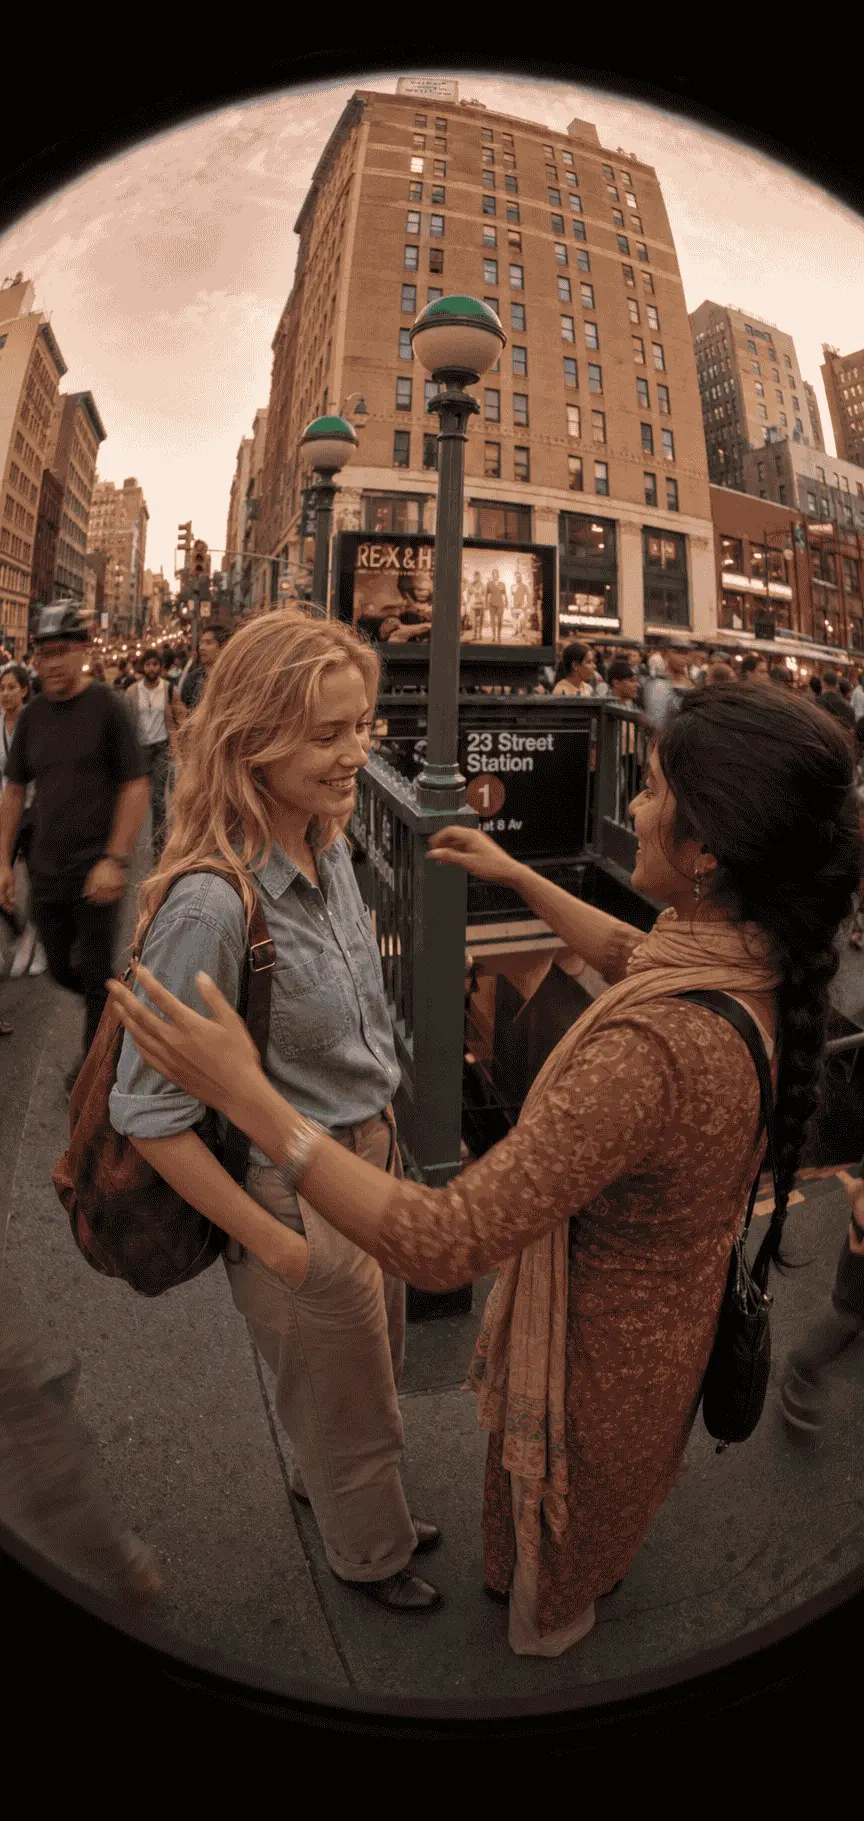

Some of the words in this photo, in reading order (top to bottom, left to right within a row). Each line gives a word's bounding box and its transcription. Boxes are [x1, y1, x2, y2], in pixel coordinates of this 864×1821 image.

[357, 545, 400, 568] REX
[403, 547, 416, 569] &
[418, 547, 436, 570] H
[467, 733, 493, 752] 23
[498, 732, 555, 752] Street
[466, 753, 534, 773] Station
[478, 783, 490, 808] 1
[482, 820, 495, 831] at
[496, 819, 505, 831] 8
[507, 818, 523, 831] Av
